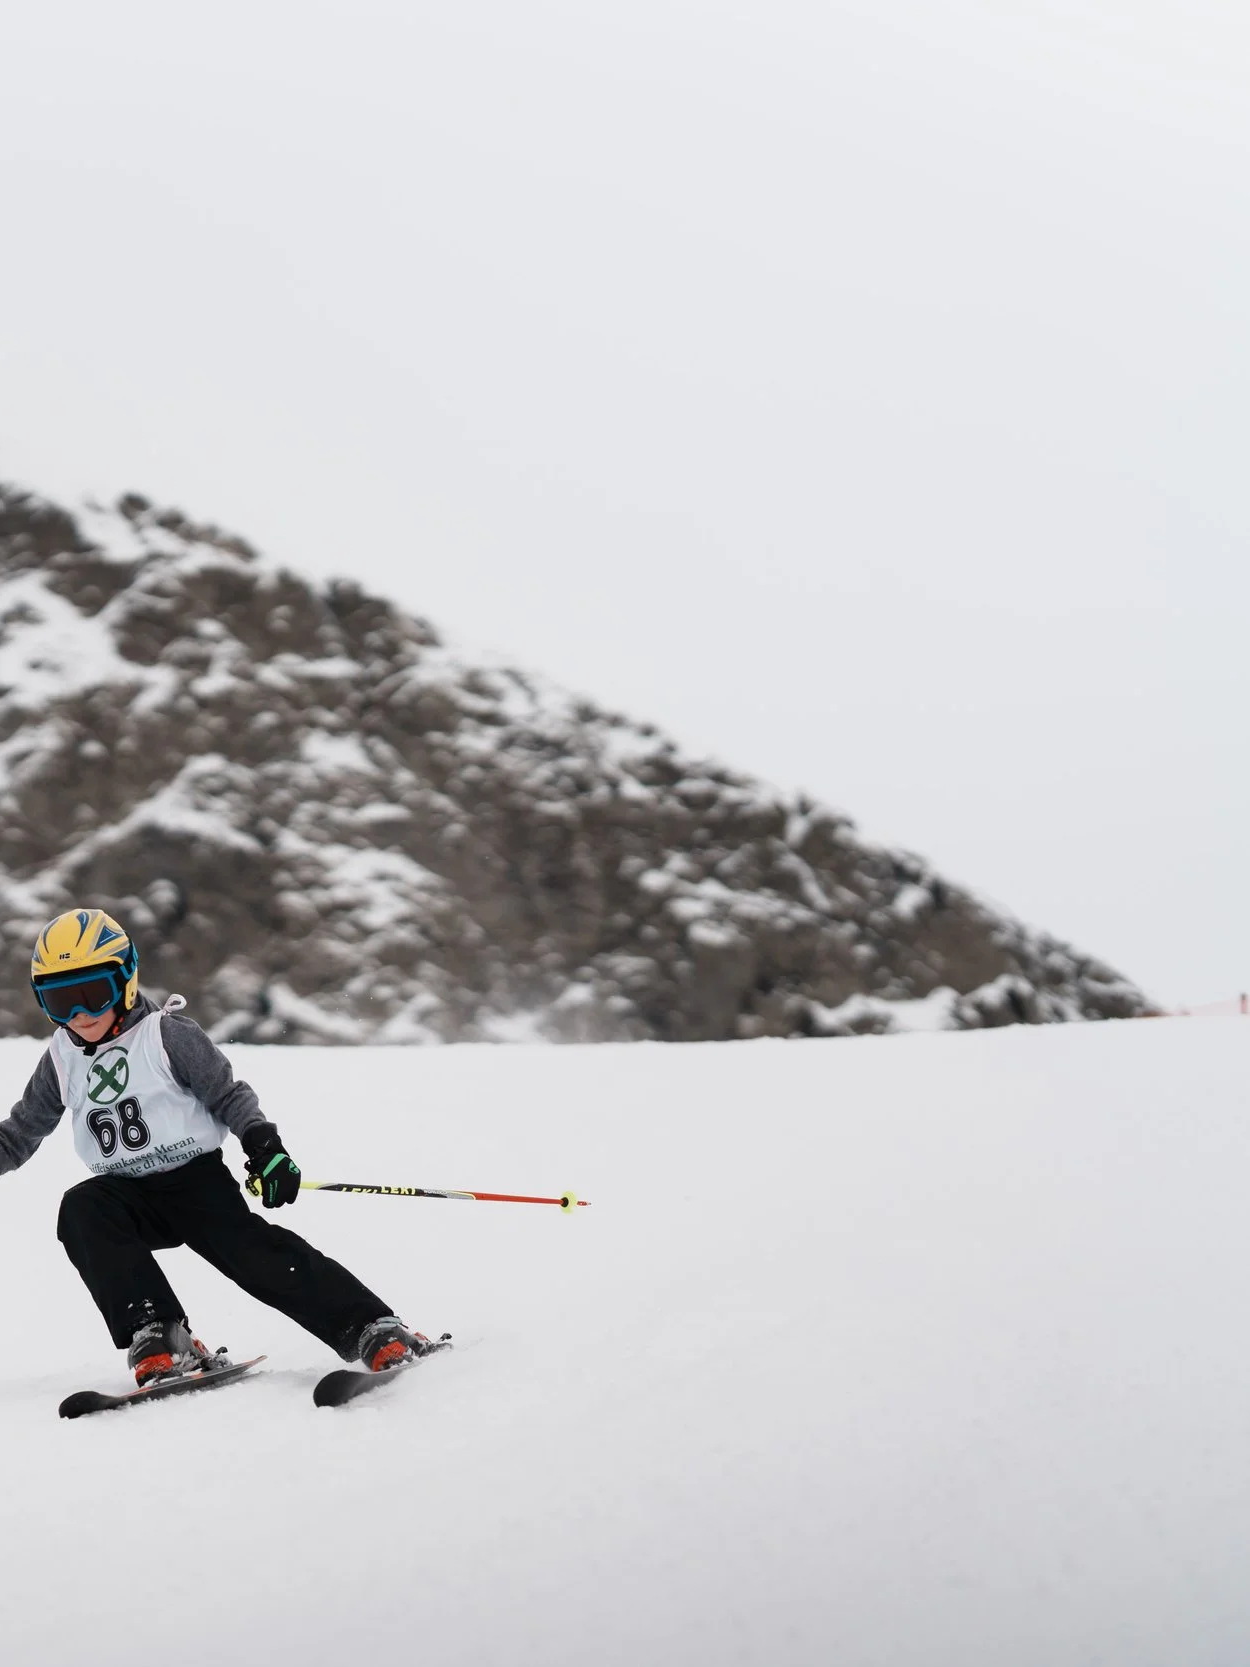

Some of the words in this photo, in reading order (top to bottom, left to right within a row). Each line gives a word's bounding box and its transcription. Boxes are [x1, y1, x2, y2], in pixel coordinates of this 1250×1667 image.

[86, 1096, 151, 1158] 68
[86, 1151, 153, 1174] iffeisenkasse
[153, 1136, 196, 1155] Meran
[144, 1158, 156, 1170] di
[158, 1146, 204, 1165] Merano
[380, 1185, 416, 1196] LEKI
